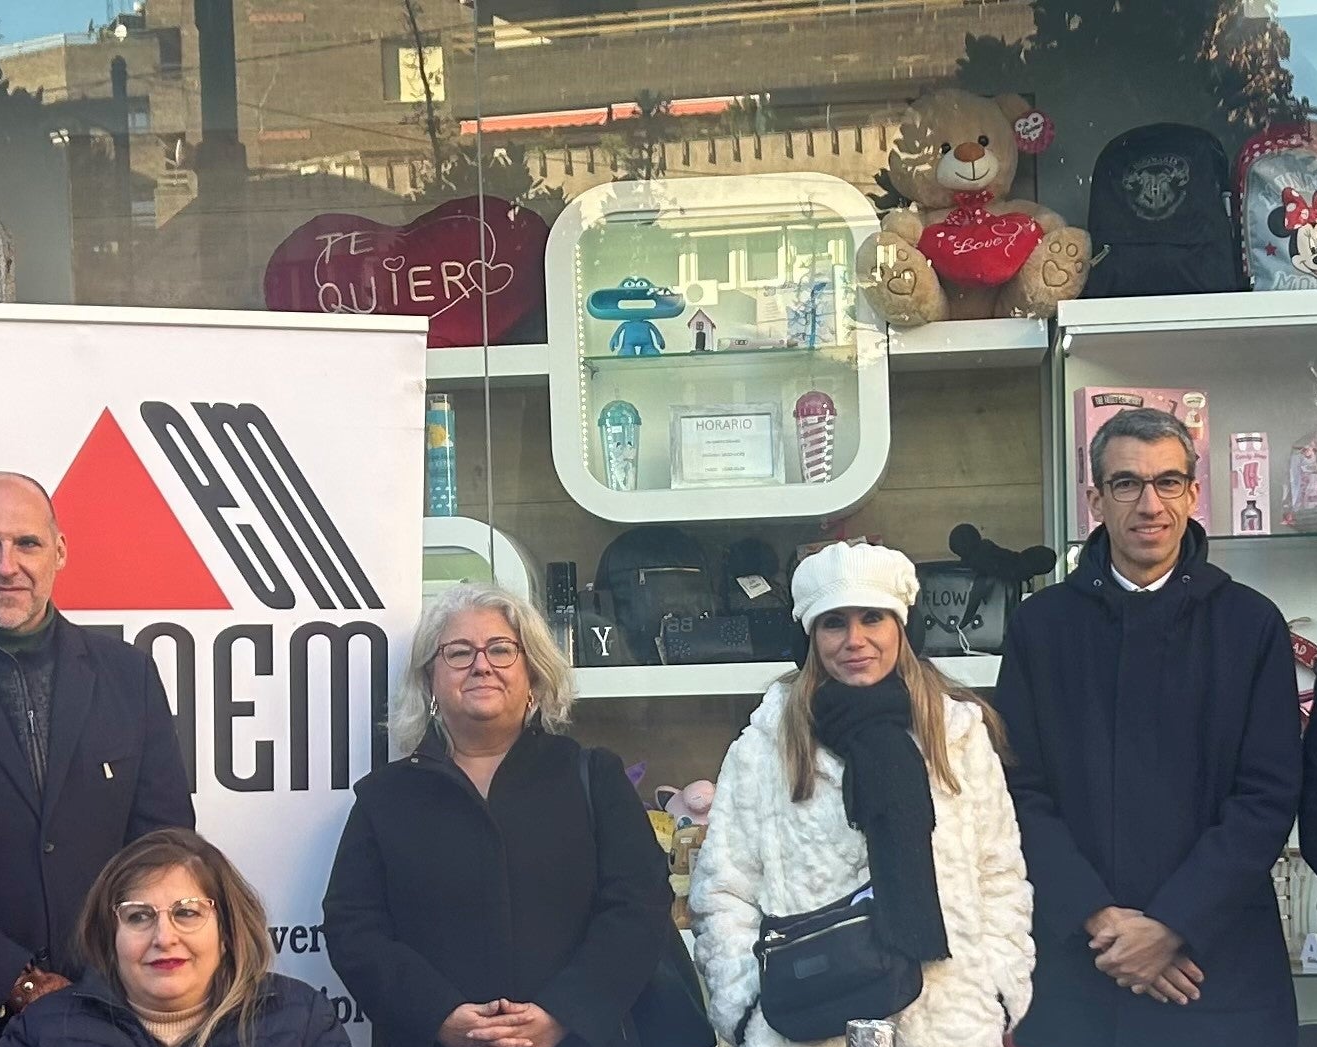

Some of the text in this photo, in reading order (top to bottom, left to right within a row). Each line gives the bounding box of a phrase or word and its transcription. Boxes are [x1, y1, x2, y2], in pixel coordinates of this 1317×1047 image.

[316, 231, 373, 263] TE
[696, 419, 752, 431] HORARIO
[592, 627, 612, 656] Y
